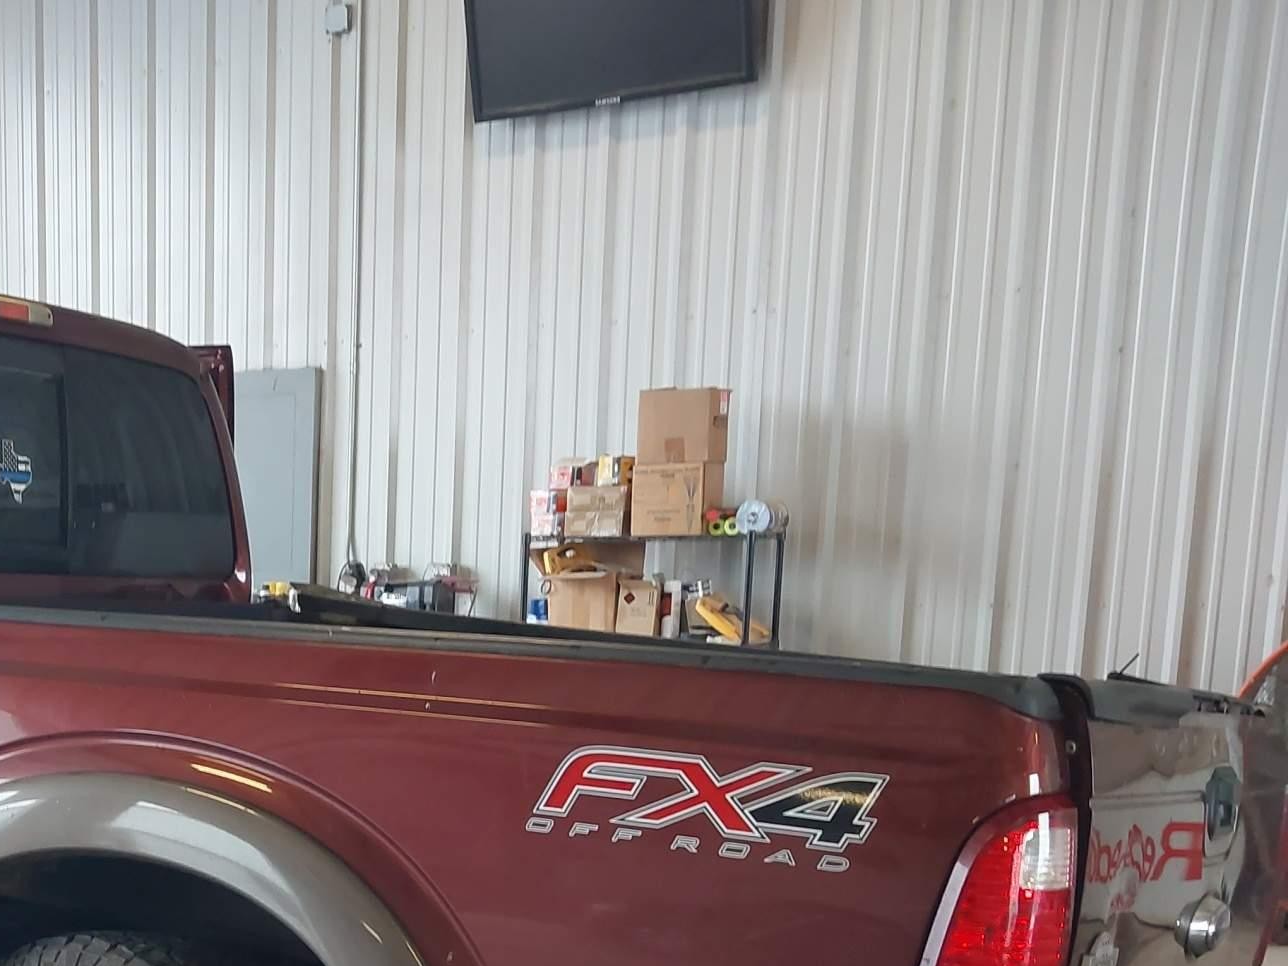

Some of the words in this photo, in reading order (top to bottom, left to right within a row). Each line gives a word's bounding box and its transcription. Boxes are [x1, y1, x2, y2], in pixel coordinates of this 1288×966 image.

[533, 744, 890, 852] FX4
[525, 817, 642, 842] OFF
[670, 835, 850, 873] ROAD
